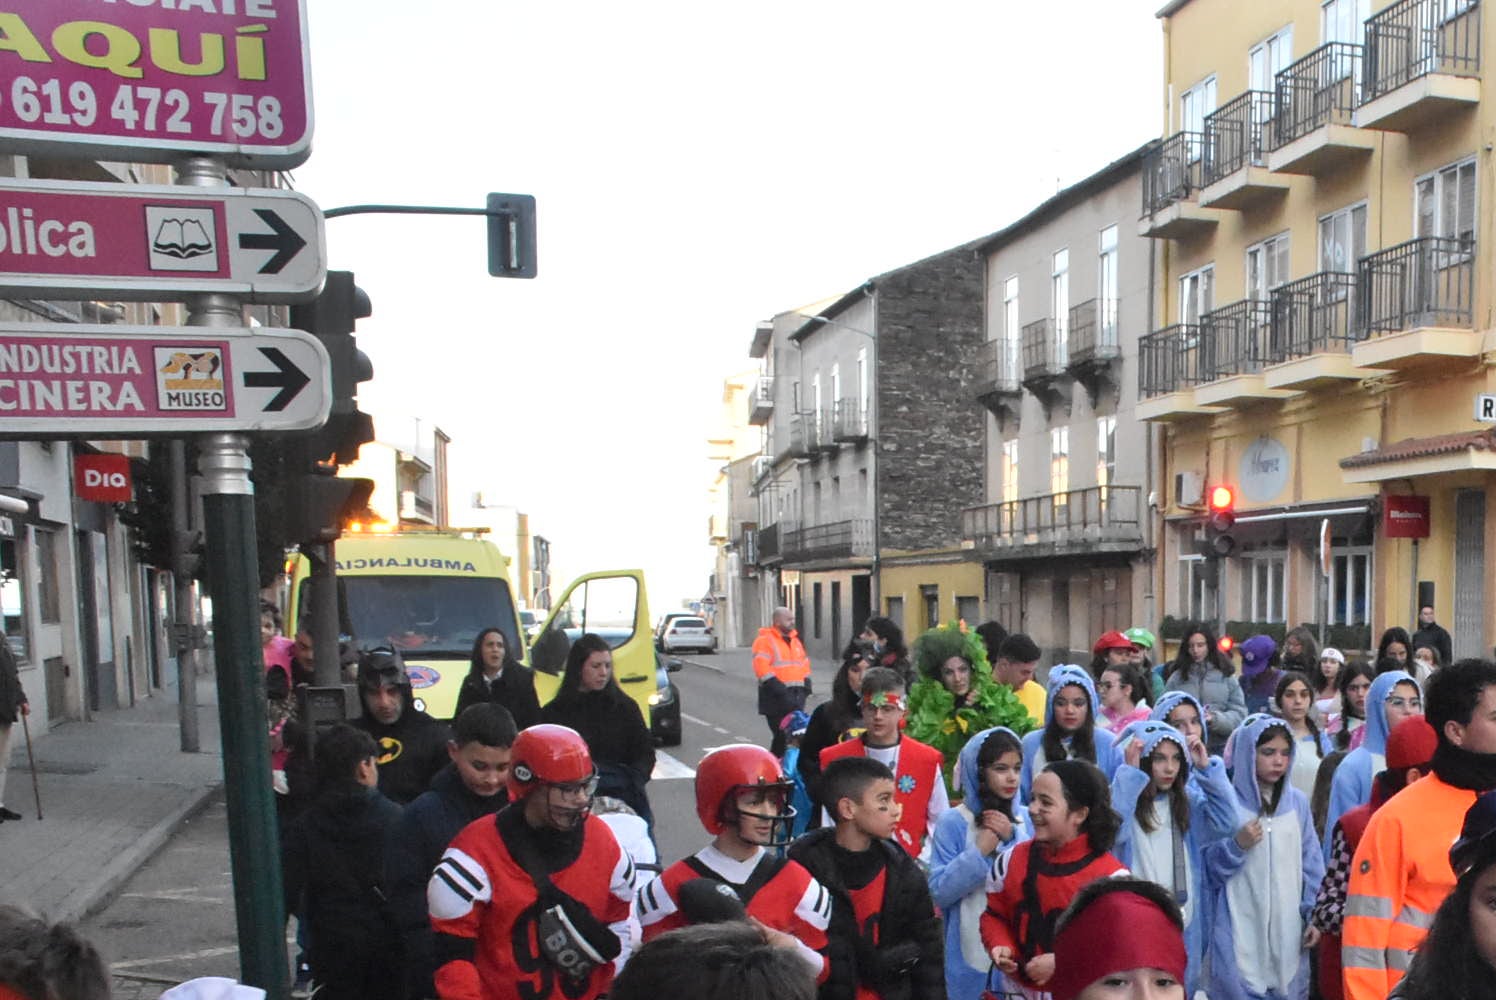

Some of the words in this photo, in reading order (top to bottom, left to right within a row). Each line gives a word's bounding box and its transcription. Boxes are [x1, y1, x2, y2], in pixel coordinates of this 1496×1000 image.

[0, 12, 269, 80] AQUÍ
[11, 76, 97, 127] 619
[110, 85, 192, 134] 472
[203, 92, 284, 139] 758
[0, 207, 96, 257] lica
[166, 392, 224, 407] MUSEO
